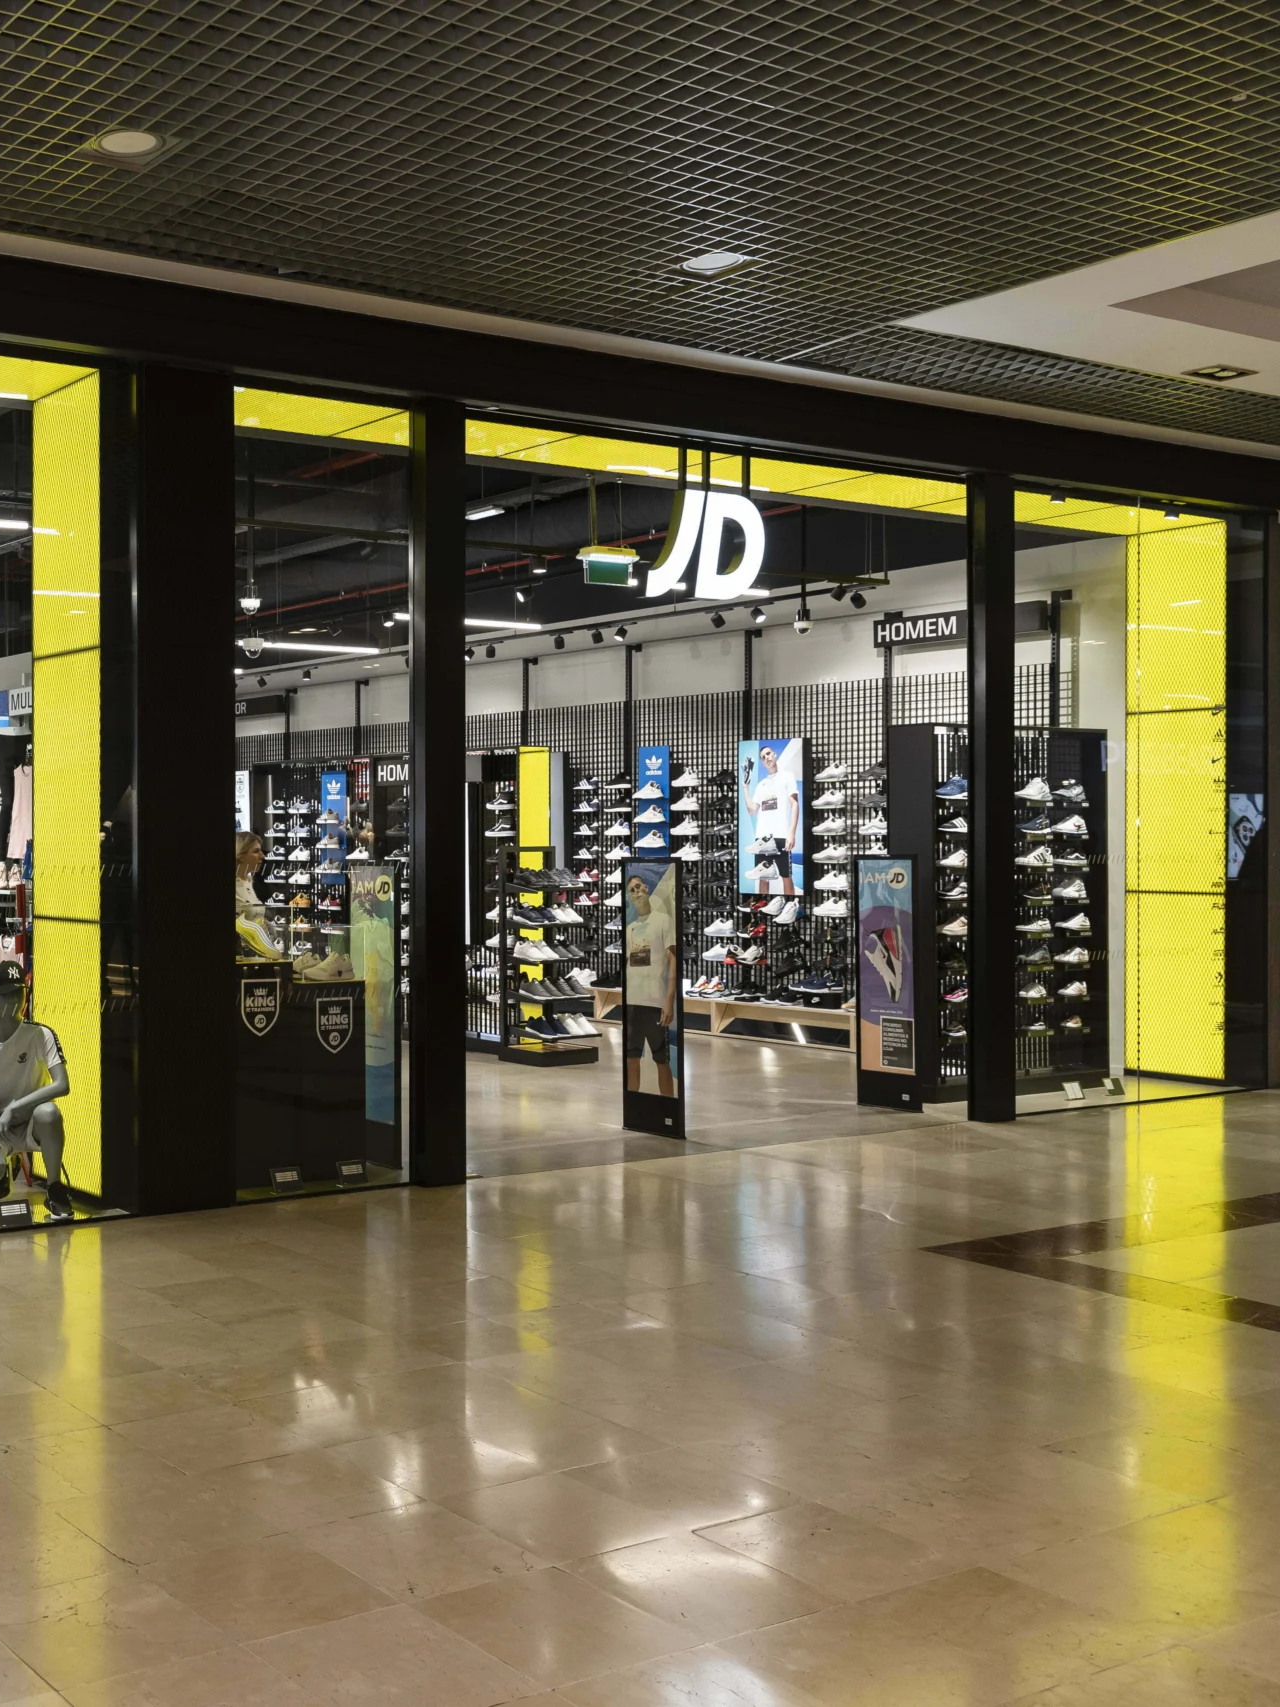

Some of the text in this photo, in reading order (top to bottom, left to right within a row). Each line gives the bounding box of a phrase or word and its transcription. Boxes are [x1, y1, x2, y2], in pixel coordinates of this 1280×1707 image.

[646, 489, 765, 600] JD
[877, 616, 957, 643] HOMEM
[377, 764, 408, 782] HOM
[889, 872, 905, 883] JD
[356, 881, 373, 894] AM
[377, 881, 390, 894] JD
[245, 997, 275, 1007] KING
[320, 1014, 349, 1025] KING
